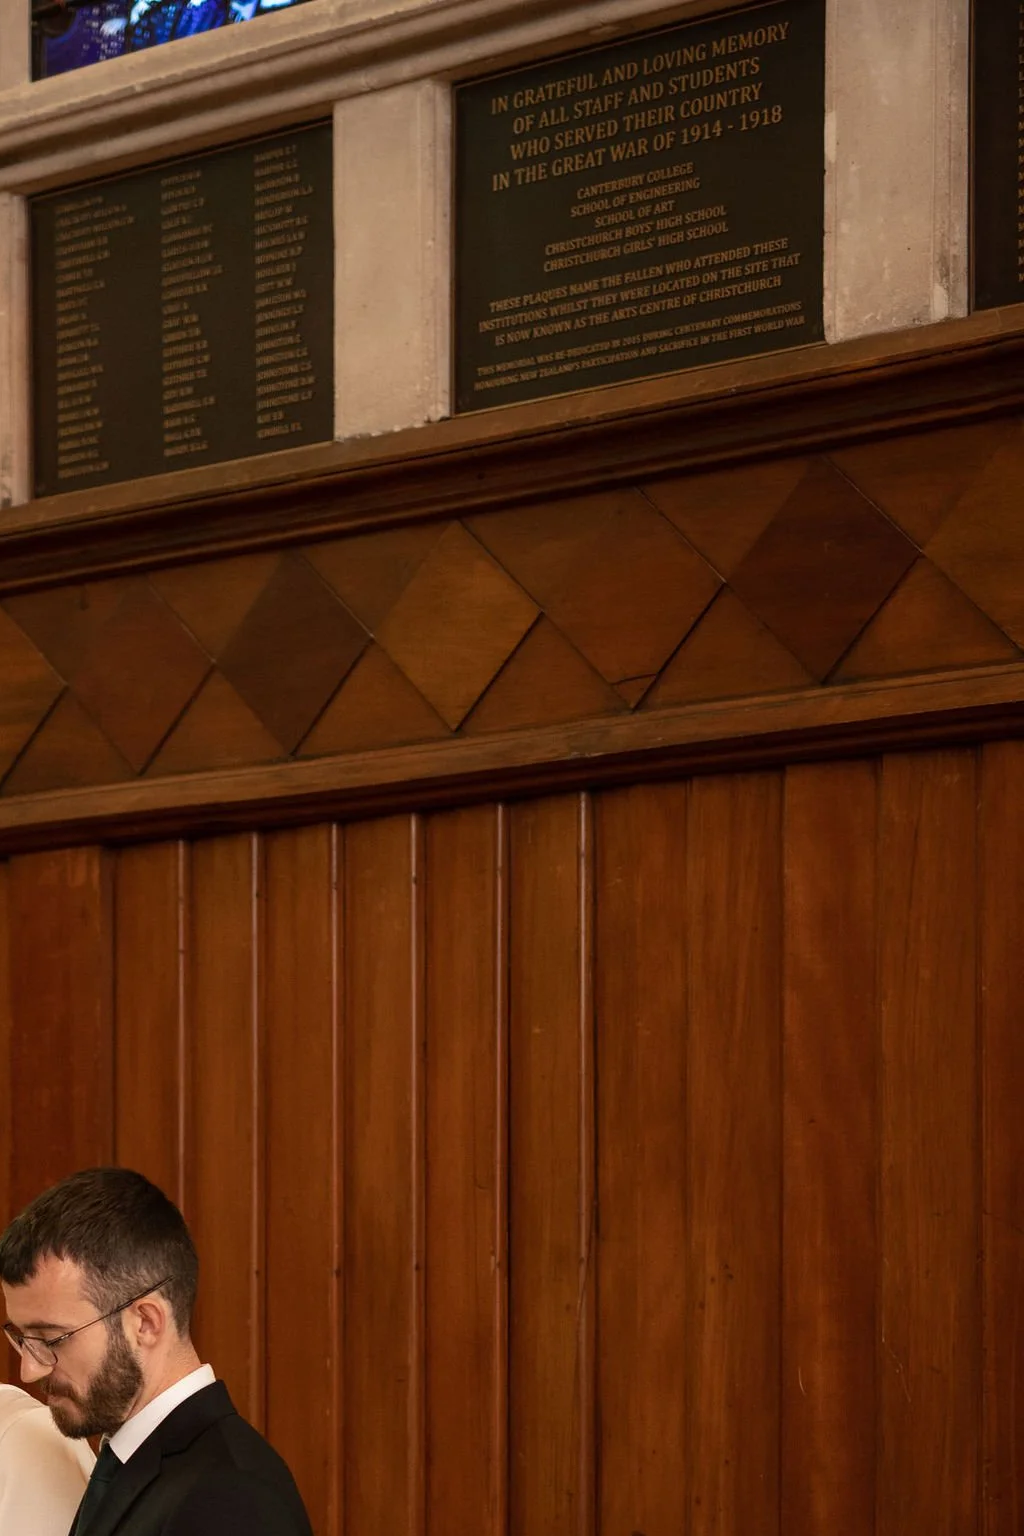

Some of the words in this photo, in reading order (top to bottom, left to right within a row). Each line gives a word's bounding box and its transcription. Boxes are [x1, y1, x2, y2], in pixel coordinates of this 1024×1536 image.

[491, 95, 508, 114] IN
[512, 72, 597, 108] GRATEFUL
[602, 61, 637, 85] AND
[642, 43, 705, 75] LOVING
[711, 21, 789, 57] MEMORY
[512, 114, 534, 134] OF
[538, 106, 569, 128] ALL
[573, 91, 623, 119] STAFF
[627, 81, 662, 105] AND
[668, 56, 759, 94] STUDENTS
[492, 171, 509, 191] IN
[514, 162, 547, 185] THE
[551, 147, 605, 176] GREAT
[609, 137, 648, 161] WAR
[653, 130, 675, 151] OF
[681, 119, 722, 144] 1914
[739, 104, 782, 131] 1918
[509, 136, 550, 160] WHO
[554, 119, 618, 149] SERVED
[622, 104, 674, 132] THEIR
[679, 81, 762, 118] COUNTRY
[570, 198, 610, 217] SCHOOL
[612, 194, 626, 207] OF
[628, 176, 700, 203] ENGINEERING
[576, 173, 644, 199] CANTERBURY
[646, 161, 693, 182] COLLEGE
[594, 209, 634, 227] SCHOOL
[637, 205, 651, 217] OF
[653, 199, 674, 214] ART
[543, 245, 620, 272] CHRISTCHURCH
[657, 231, 683, 246] HIGH
[686, 221, 728, 240] SCHOOL
[544, 228, 622, 255] CHRISTCHURCH
[656, 214, 682, 229] HIGH
[684, 204, 726, 223] SCHOOL
[478, 307, 547, 332] INSTITUTIONS
[549, 298, 588, 316] WHILST
[590, 292, 617, 307] THEY
[619, 285, 650, 301] WERE
[652, 275, 700, 295] LOCATED
[702, 271, 717, 283] ON
[720, 265, 742, 280] THE
[744, 259, 768, 275] SITE
[770, 252, 800, 268] THAT
[488, 296, 520, 312] THESE
[522, 285, 567, 305] PLAQUES
[569, 279, 599, 295] NAME
[600, 273, 622, 287] THE
[623, 264, 662, 283] FALLEN
[665, 258, 691, 274] WHO
[693, 245, 750, 268] ATTENDED
[752, 237, 788, 255] THESE
[494, 333, 504, 345] IS
[506, 329, 530, 343] NOW
[532, 320, 571, 337] KNOWN
[573, 316, 586, 329] AS
[587, 311, 609, 325] THE
[611, 305, 637, 321] ARTS
[638, 296, 680, 315] CENTRE
[682, 292, 696, 305] OF
[698, 274, 781, 302] CHRISTCHURCH
